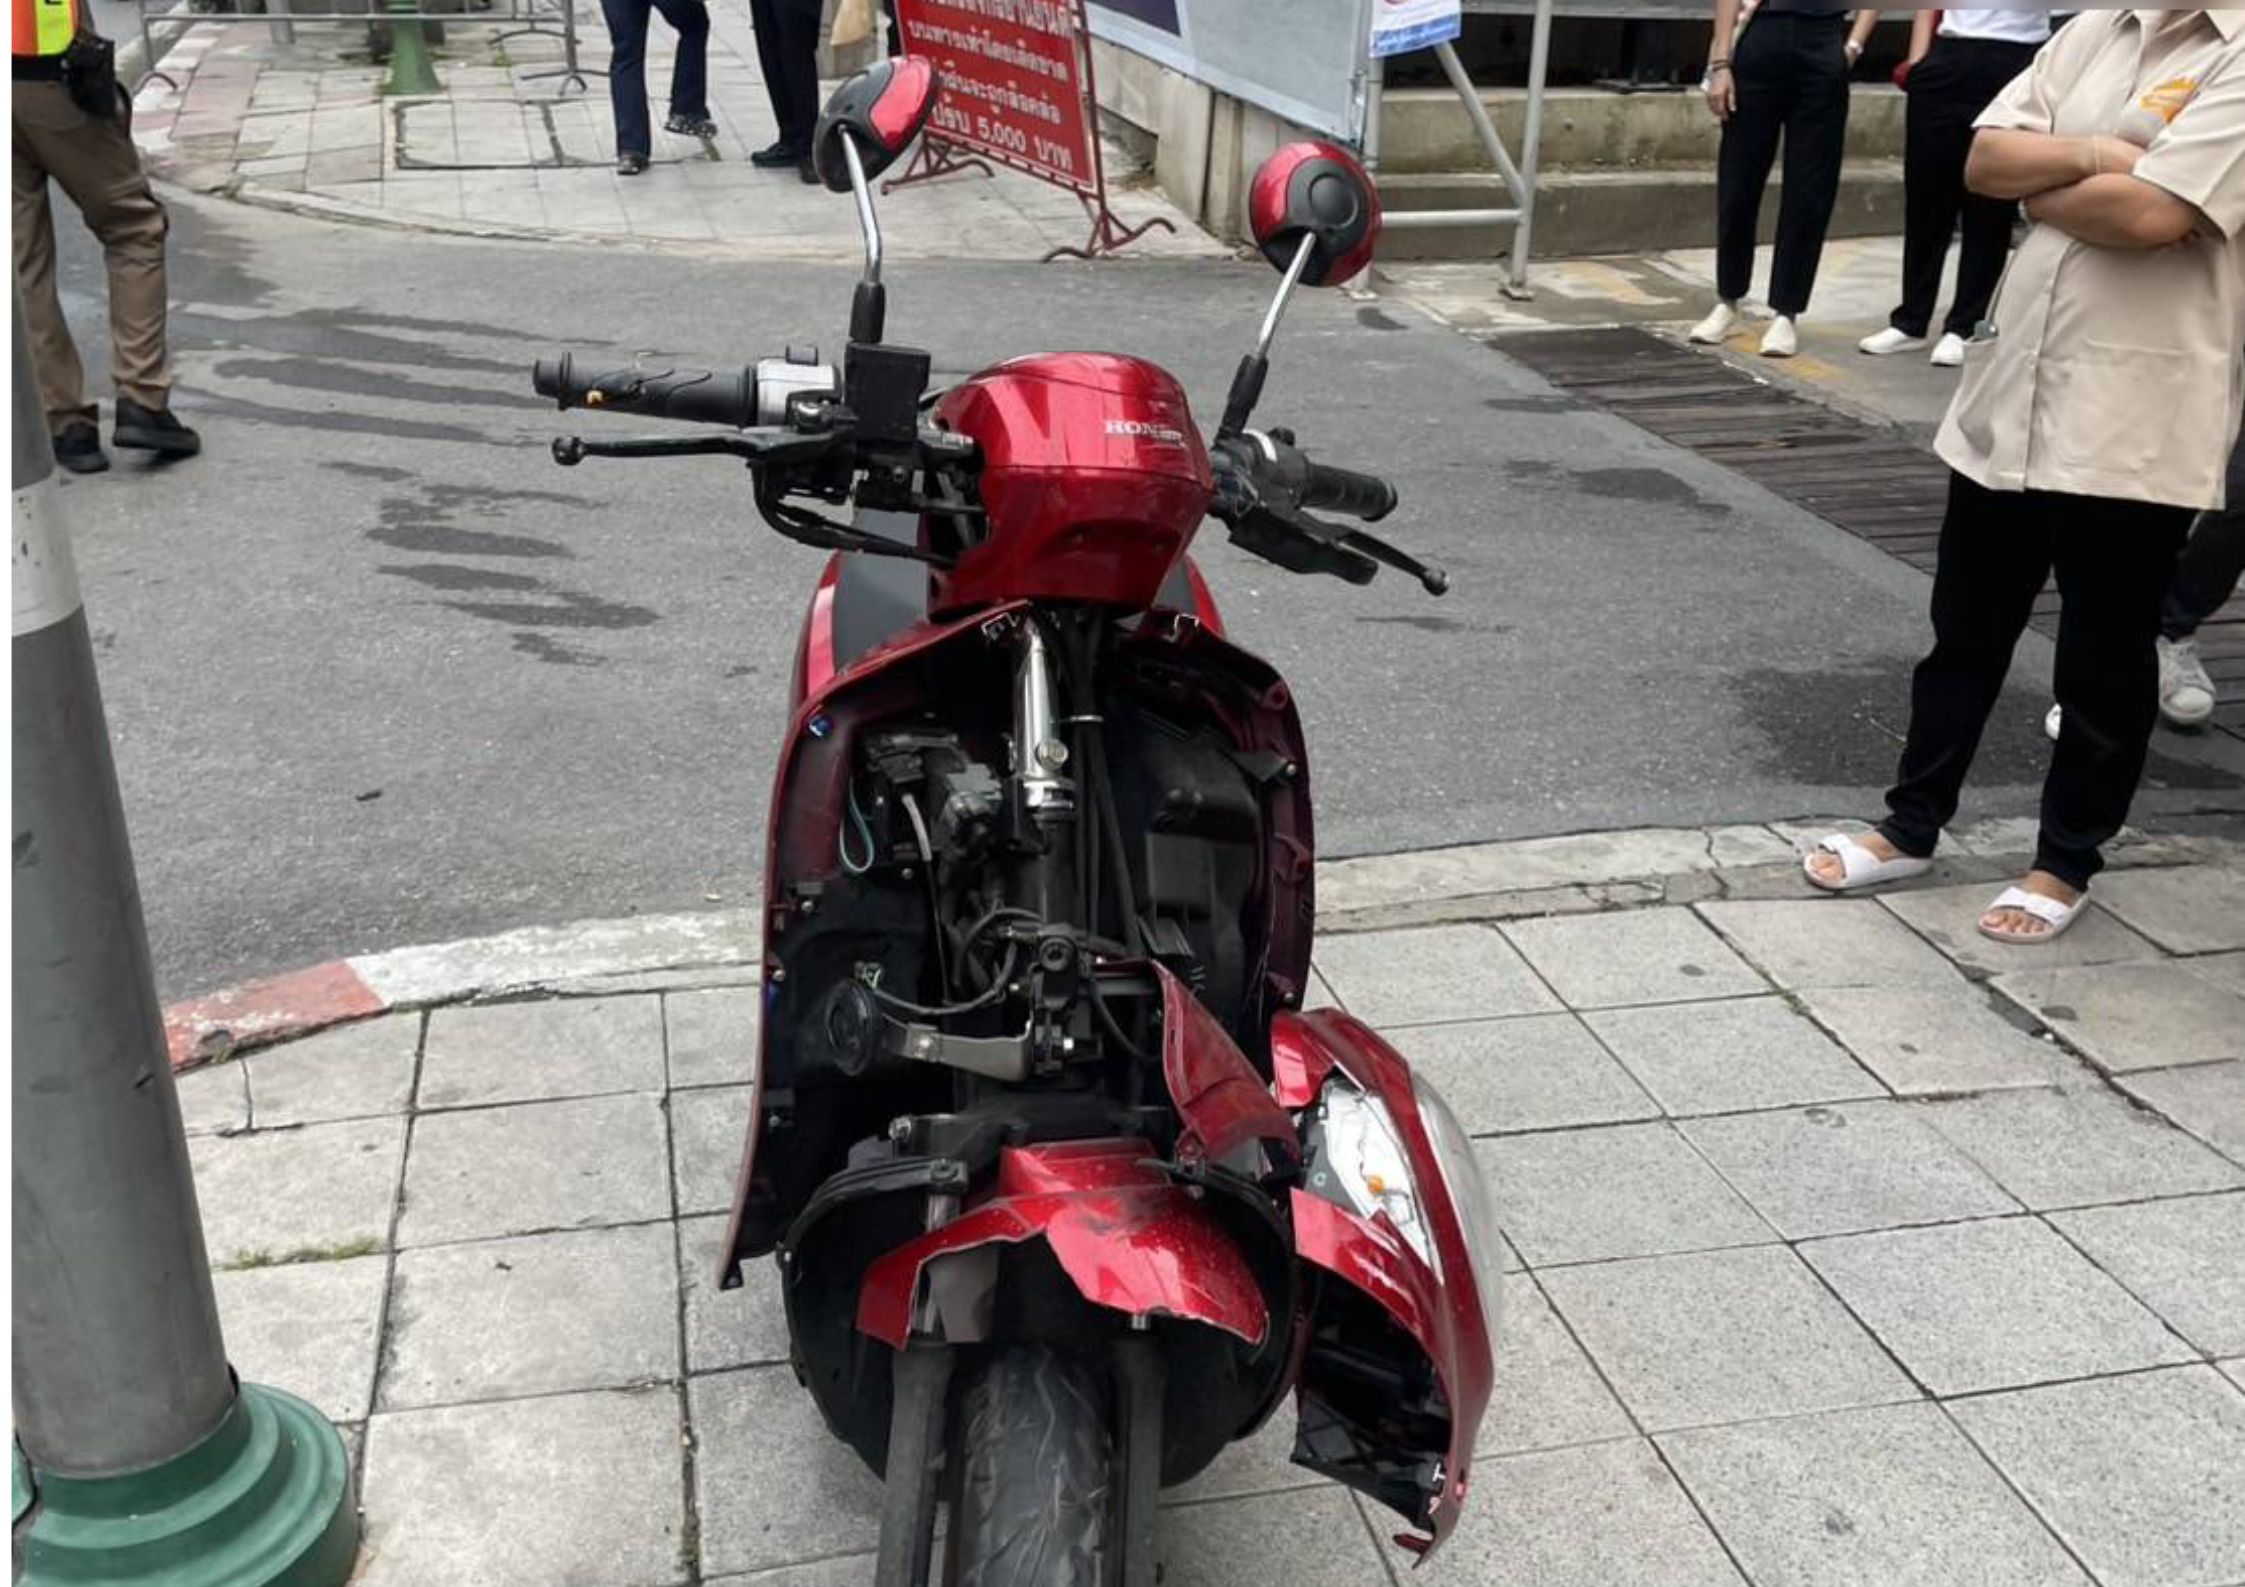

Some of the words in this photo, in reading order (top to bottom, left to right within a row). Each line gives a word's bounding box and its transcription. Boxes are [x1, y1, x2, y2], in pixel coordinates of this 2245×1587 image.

[978, 116, 1026, 151] 5,000
[1034, 136, 1073, 170] บาท
[1104, 420, 1182, 440] HON
